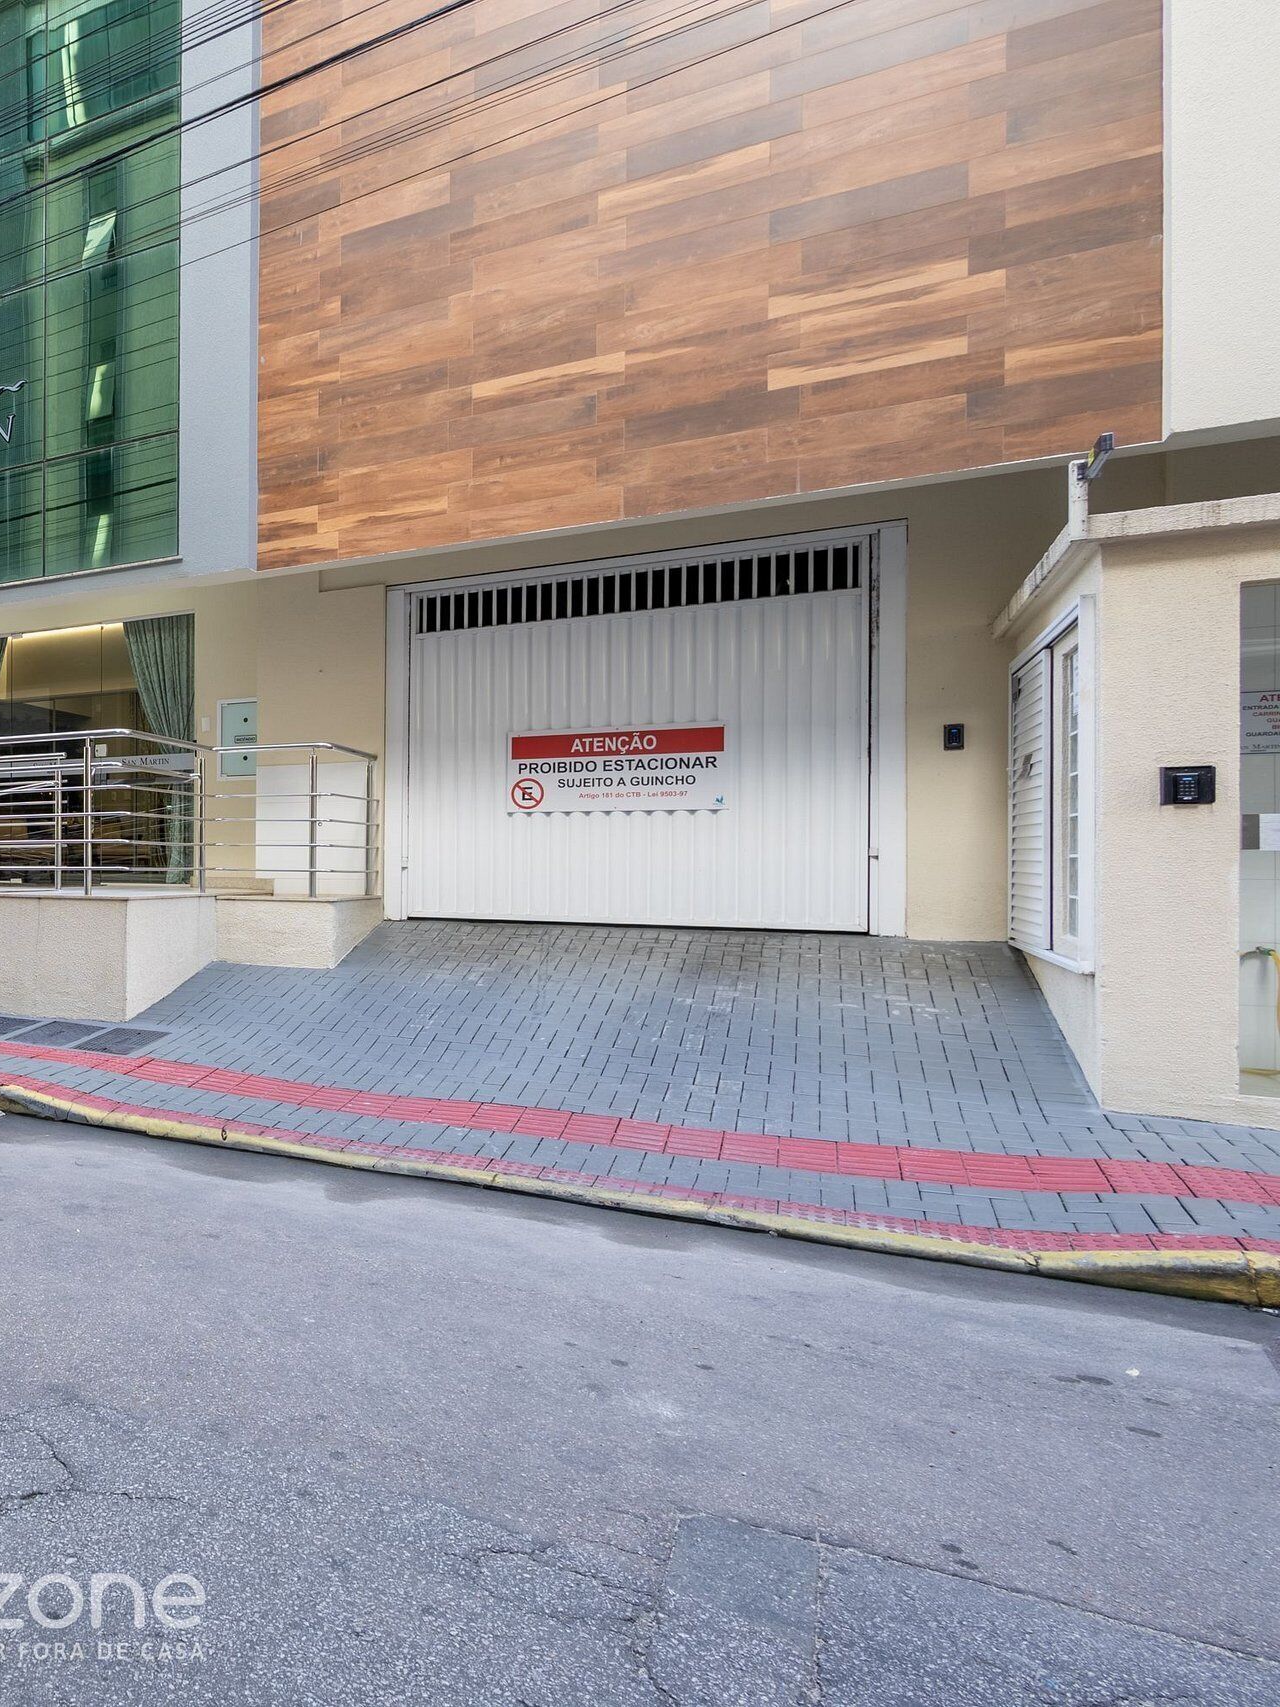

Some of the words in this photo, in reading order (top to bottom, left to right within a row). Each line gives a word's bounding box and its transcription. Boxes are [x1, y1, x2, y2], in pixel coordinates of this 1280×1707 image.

[570, 732, 658, 755] ATENÇÃO
[121, 758, 137, 766] SAN
[140, 756, 170, 766] MARTIN
[518, 759, 598, 775] PROIBIDO
[602, 755, 719, 773] ESTACIONAR
[556, 776, 614, 789] SUJEITO
[615, 777, 627, 787] A
[629, 774, 697, 786] GUINCHO
